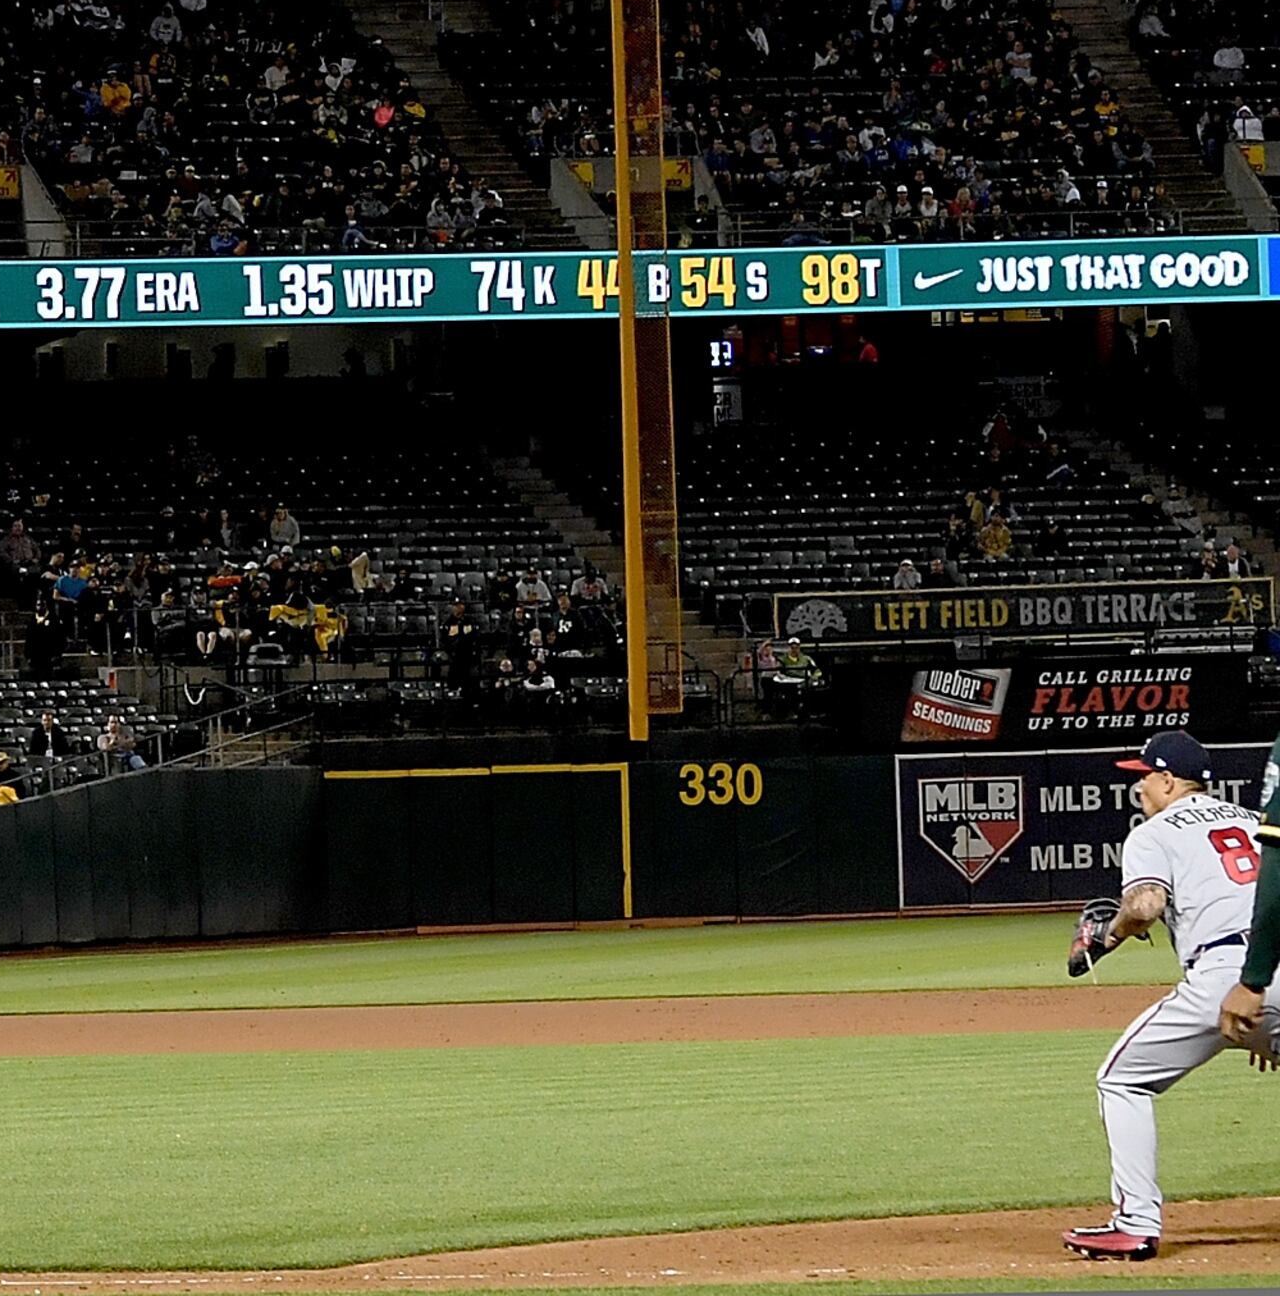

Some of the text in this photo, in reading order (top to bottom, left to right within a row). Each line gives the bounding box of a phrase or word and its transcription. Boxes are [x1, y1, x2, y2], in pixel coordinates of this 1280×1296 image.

[471, 261, 524, 312] 74
[535, 266, 556, 304] K
[680, 257, 735, 307] 54
[747, 263, 766, 300] S
[976, 251, 1248, 292] JUST THAT GOOD
[36, 265, 433, 319] 3.77 ERA 1.35 WHIP
[874, 592, 1196, 631] LEFT FIELD BBQ TERRACE
[1039, 668, 1191, 684] CALL GRILLING
[1031, 685, 1189, 713] FLAVOR
[913, 702, 992, 733] SEASONINGS
[1028, 713, 1189, 729] UP TO THE BIGS
[679, 763, 762, 805] 330
[925, 782, 1016, 812] MLB
[1040, 785, 1101, 812] MLB
[927, 811, 1016, 822] NETWORK
[1031, 844, 1098, 871] MLB
[1208, 826, 1261, 885] 8
